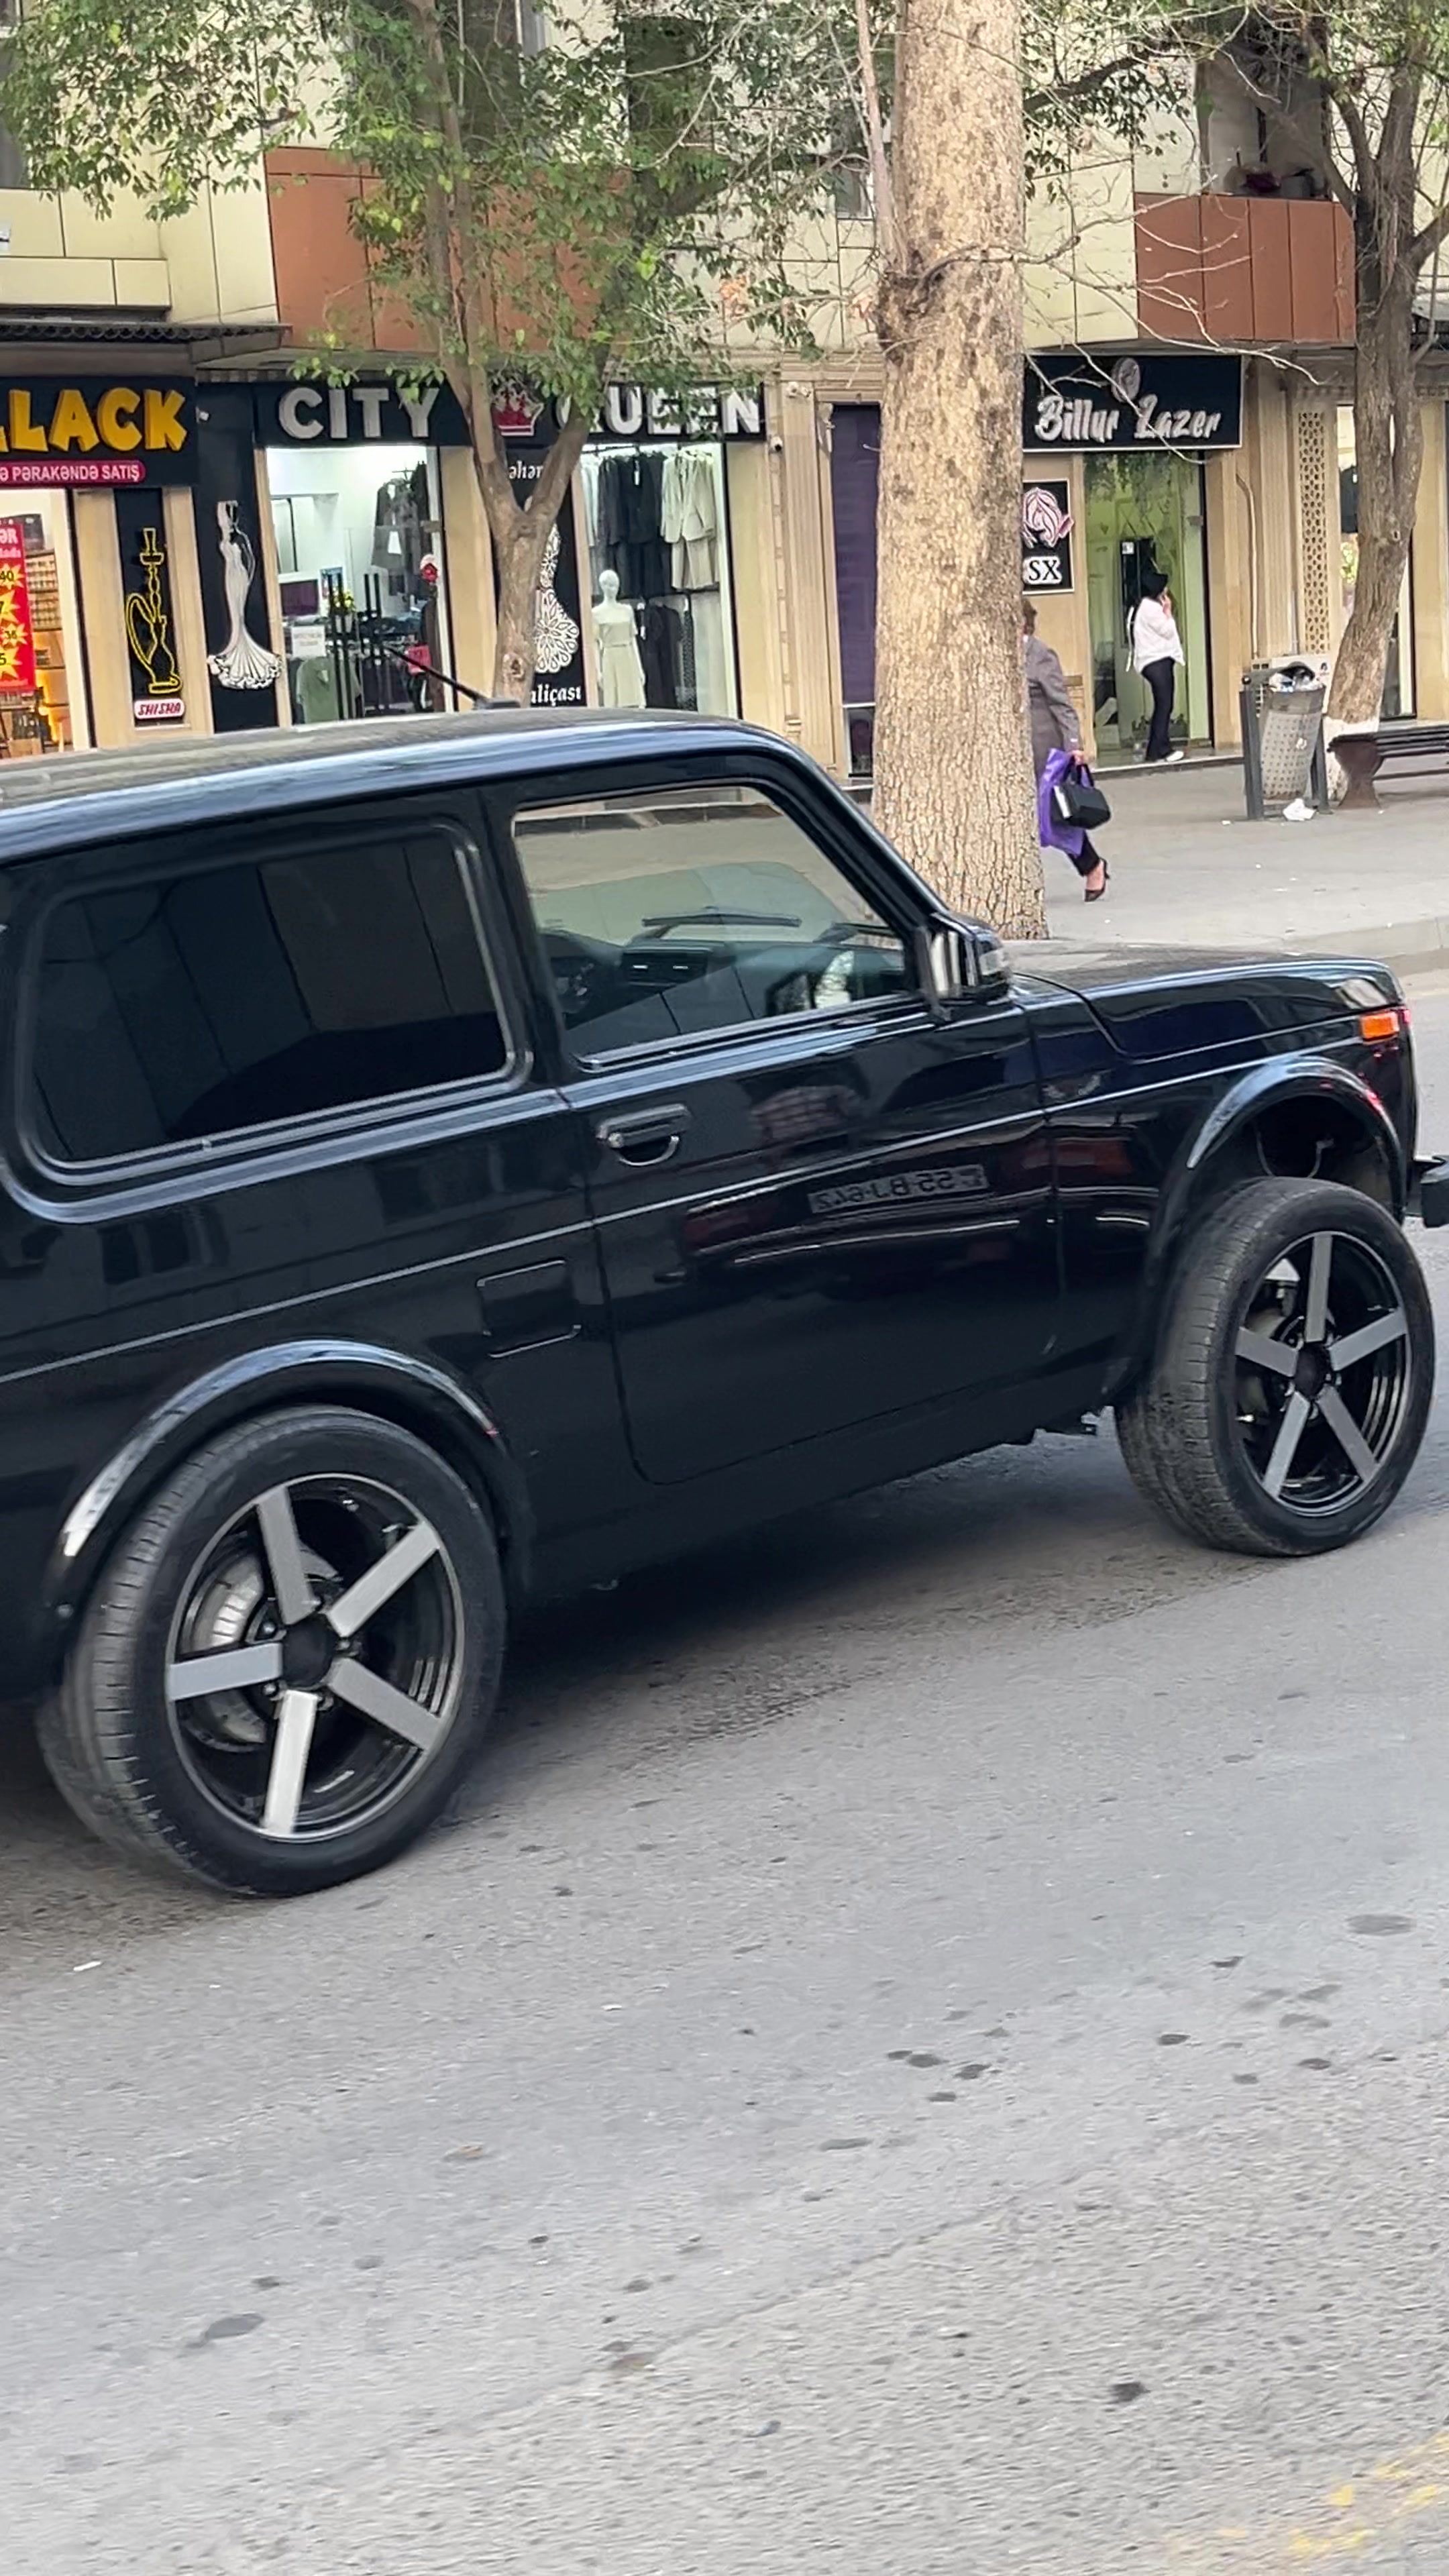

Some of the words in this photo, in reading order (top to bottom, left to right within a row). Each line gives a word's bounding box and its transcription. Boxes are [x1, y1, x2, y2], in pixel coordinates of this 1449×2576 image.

[0, 387, 187, 452] LACK
[278, 387, 439, 439] CITY
[1035, 395, 1120, 443] Billur
[1134, 393, 1221, 439] Lazer
[12, 465, 99, 482] PƏRAKƏNDƏ
[102, 464, 140, 482] SATIŞ
[509, 460, 544, 479] əhər
